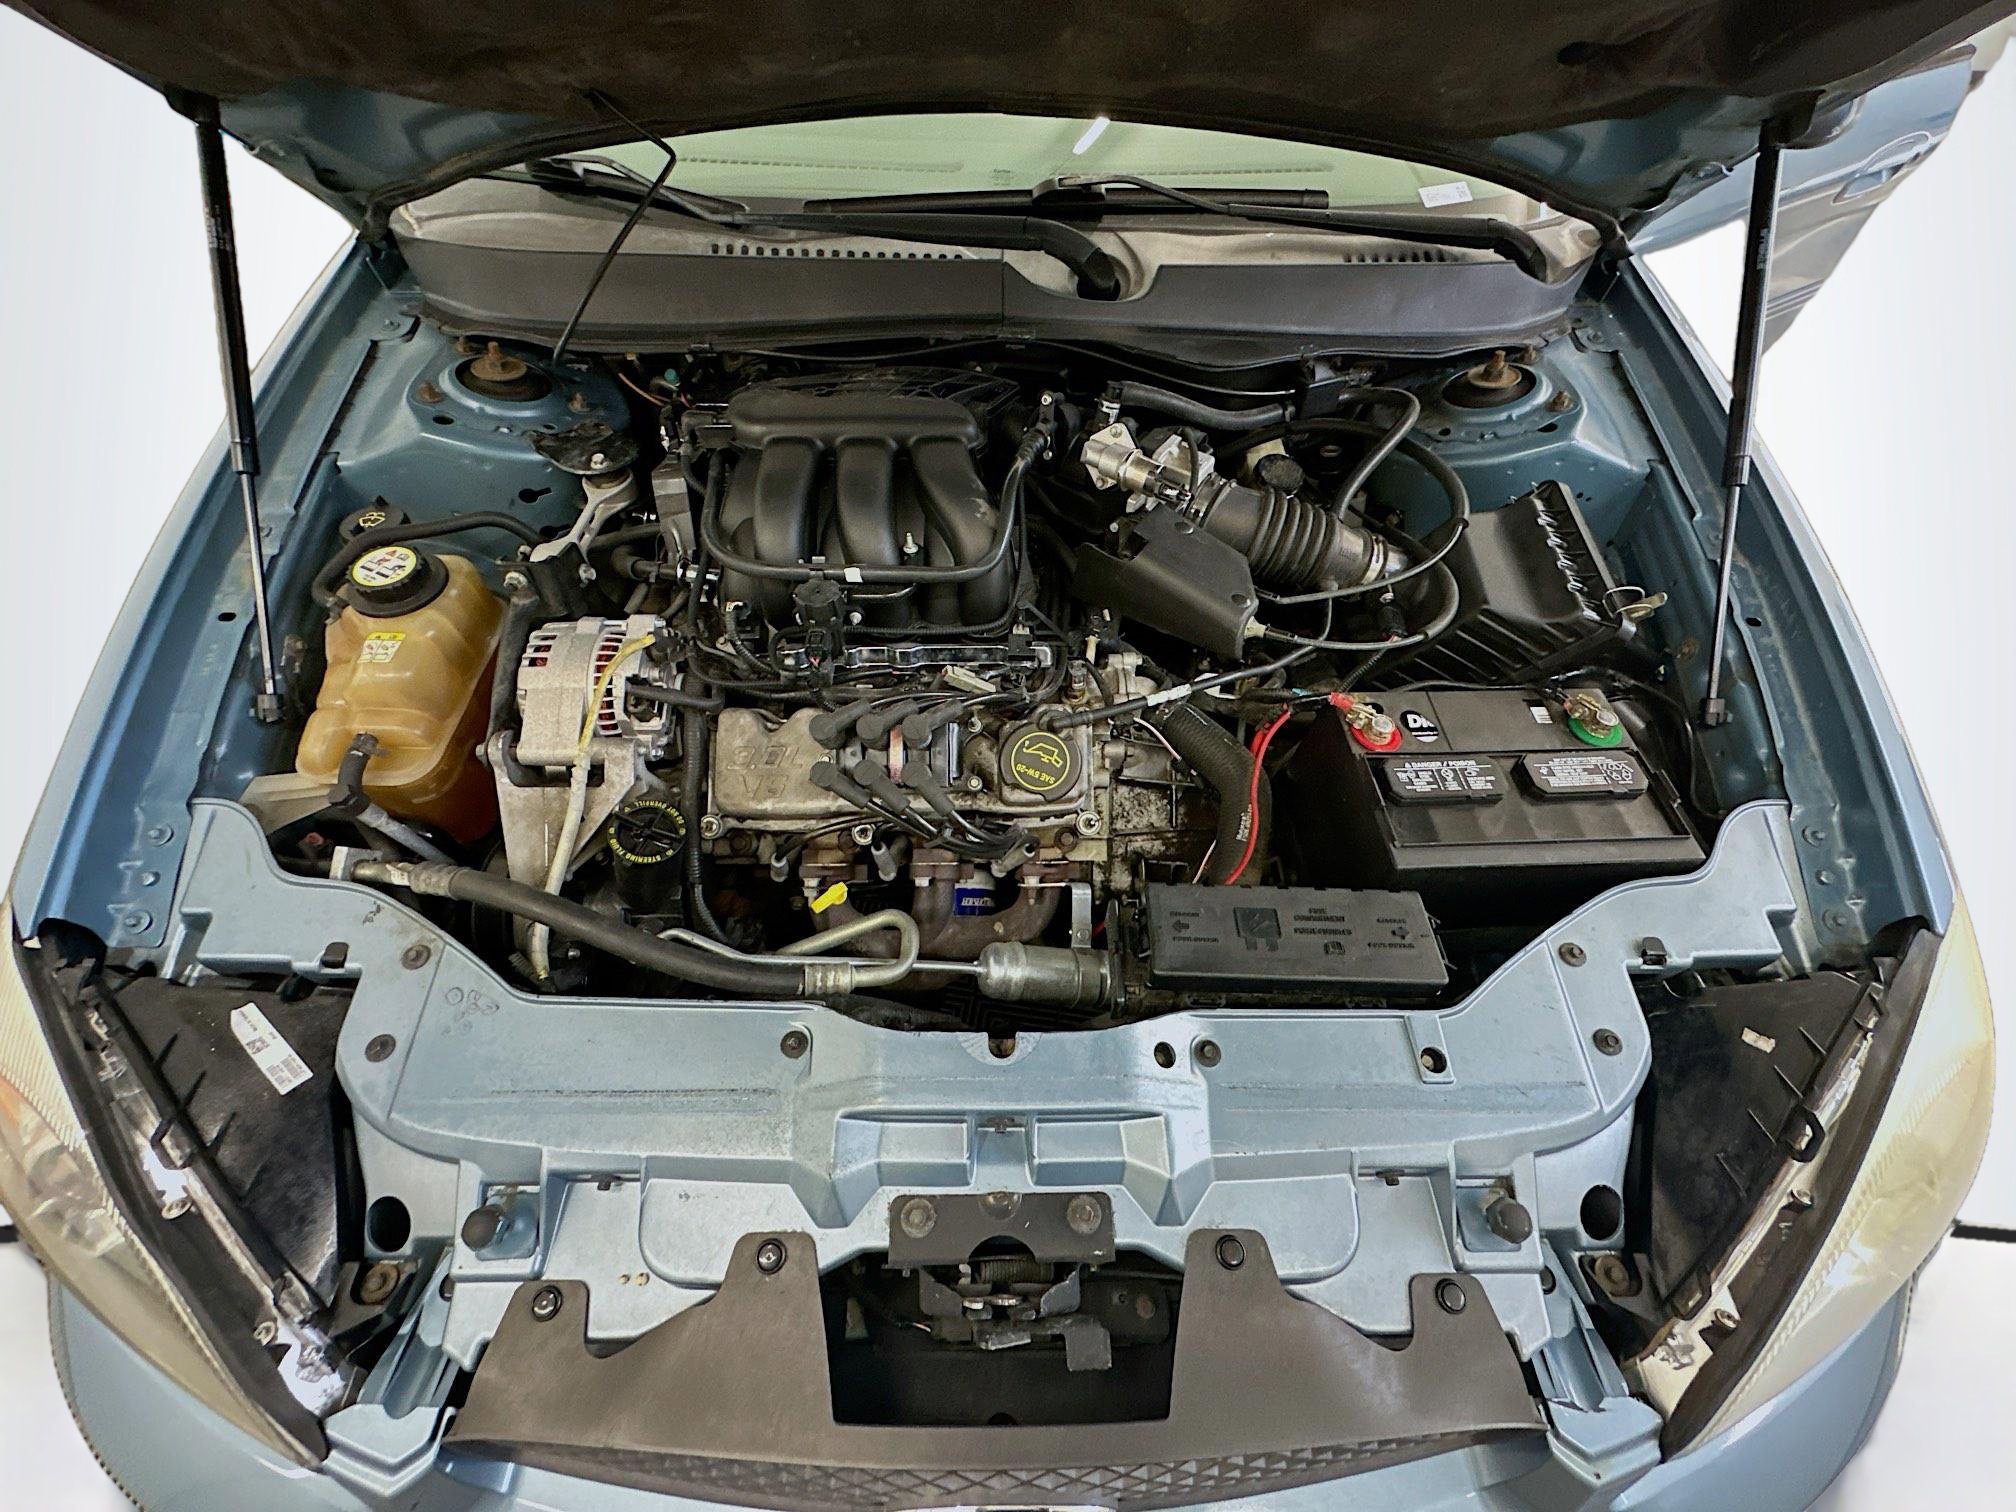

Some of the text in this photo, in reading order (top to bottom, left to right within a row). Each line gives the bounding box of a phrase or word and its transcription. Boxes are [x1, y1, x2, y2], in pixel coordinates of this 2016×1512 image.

[1016, 763, 1056, 784] SAE 5W-20
[634, 800, 667, 809] OVERFILL
[610, 838, 661, 863] STEERING FLUID
